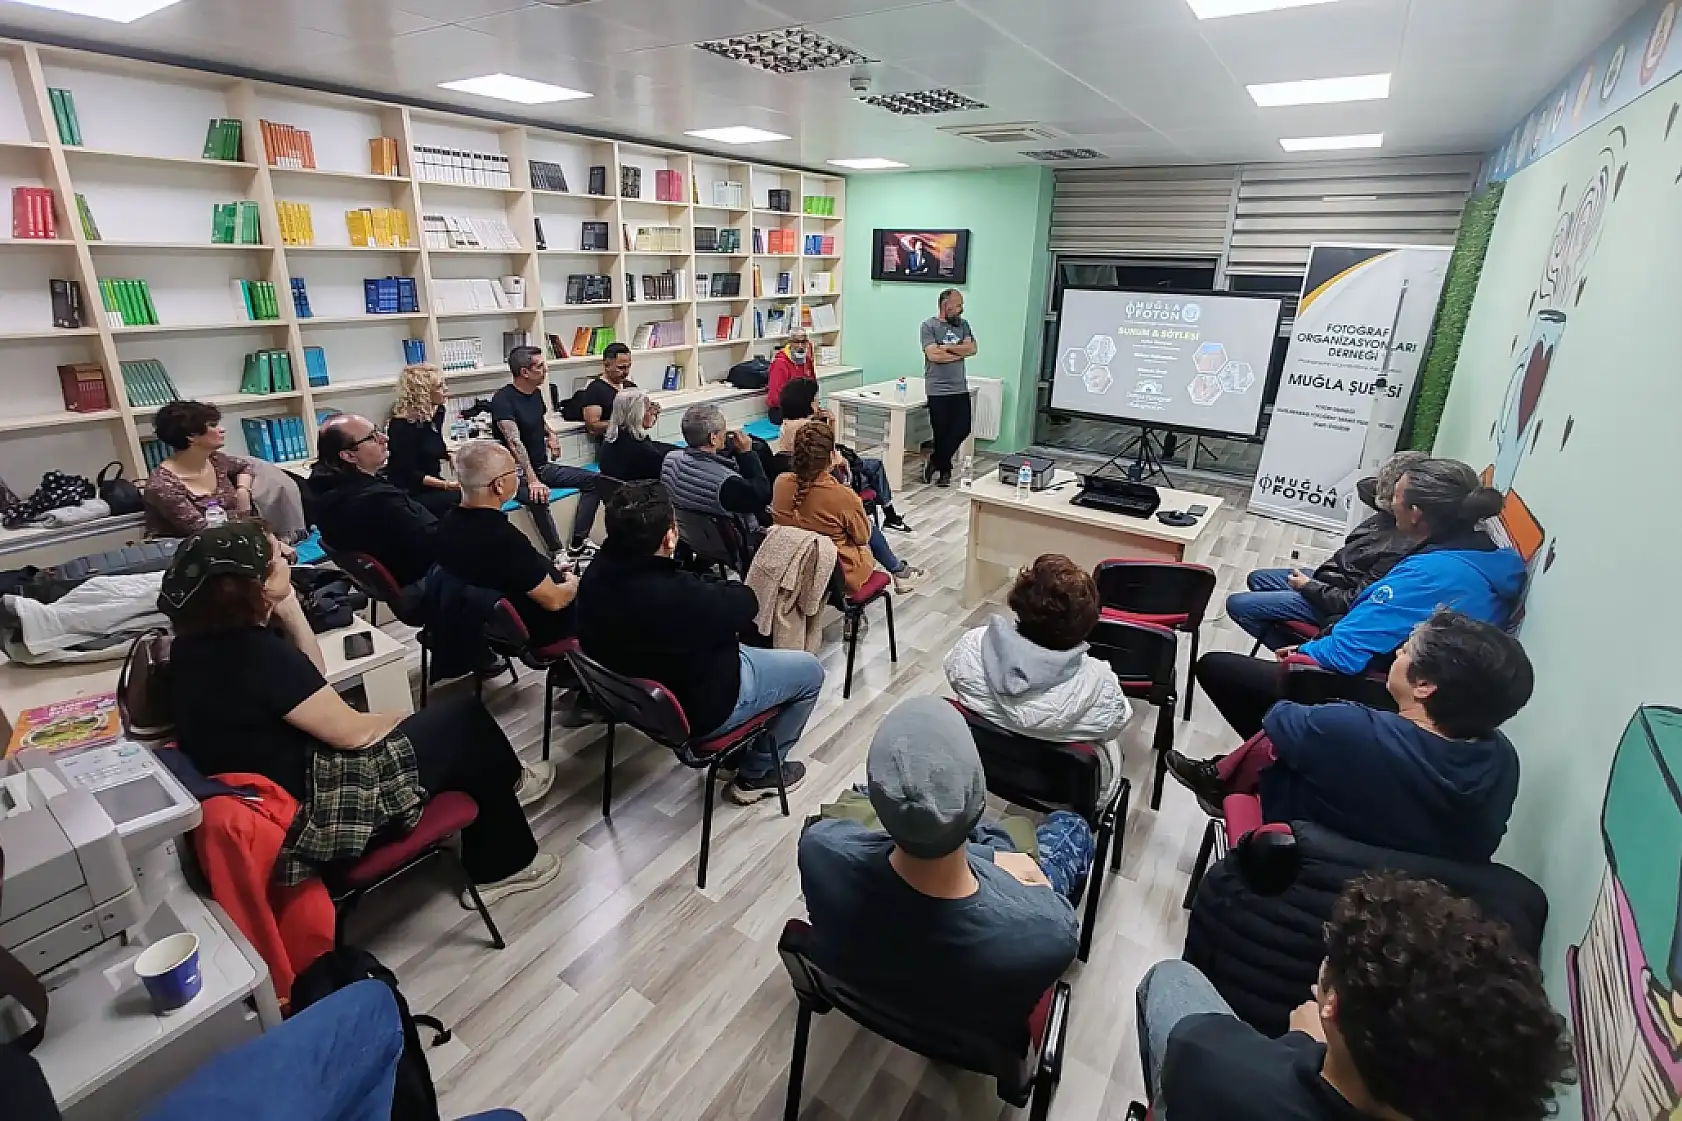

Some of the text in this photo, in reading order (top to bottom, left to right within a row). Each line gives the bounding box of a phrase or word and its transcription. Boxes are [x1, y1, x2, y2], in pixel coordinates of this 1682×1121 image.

[1135, 309, 1180, 320] FOTON
[1326, 323, 1391, 337] FOTOĞRAF
[1328, 347, 1379, 361] DERNEĞİ
[1287, 373, 1402, 399] MUĞLA ŞUBSİ
[1274, 474, 1338, 496] MUĞLA
[1272, 484, 1337, 509] FOTON
